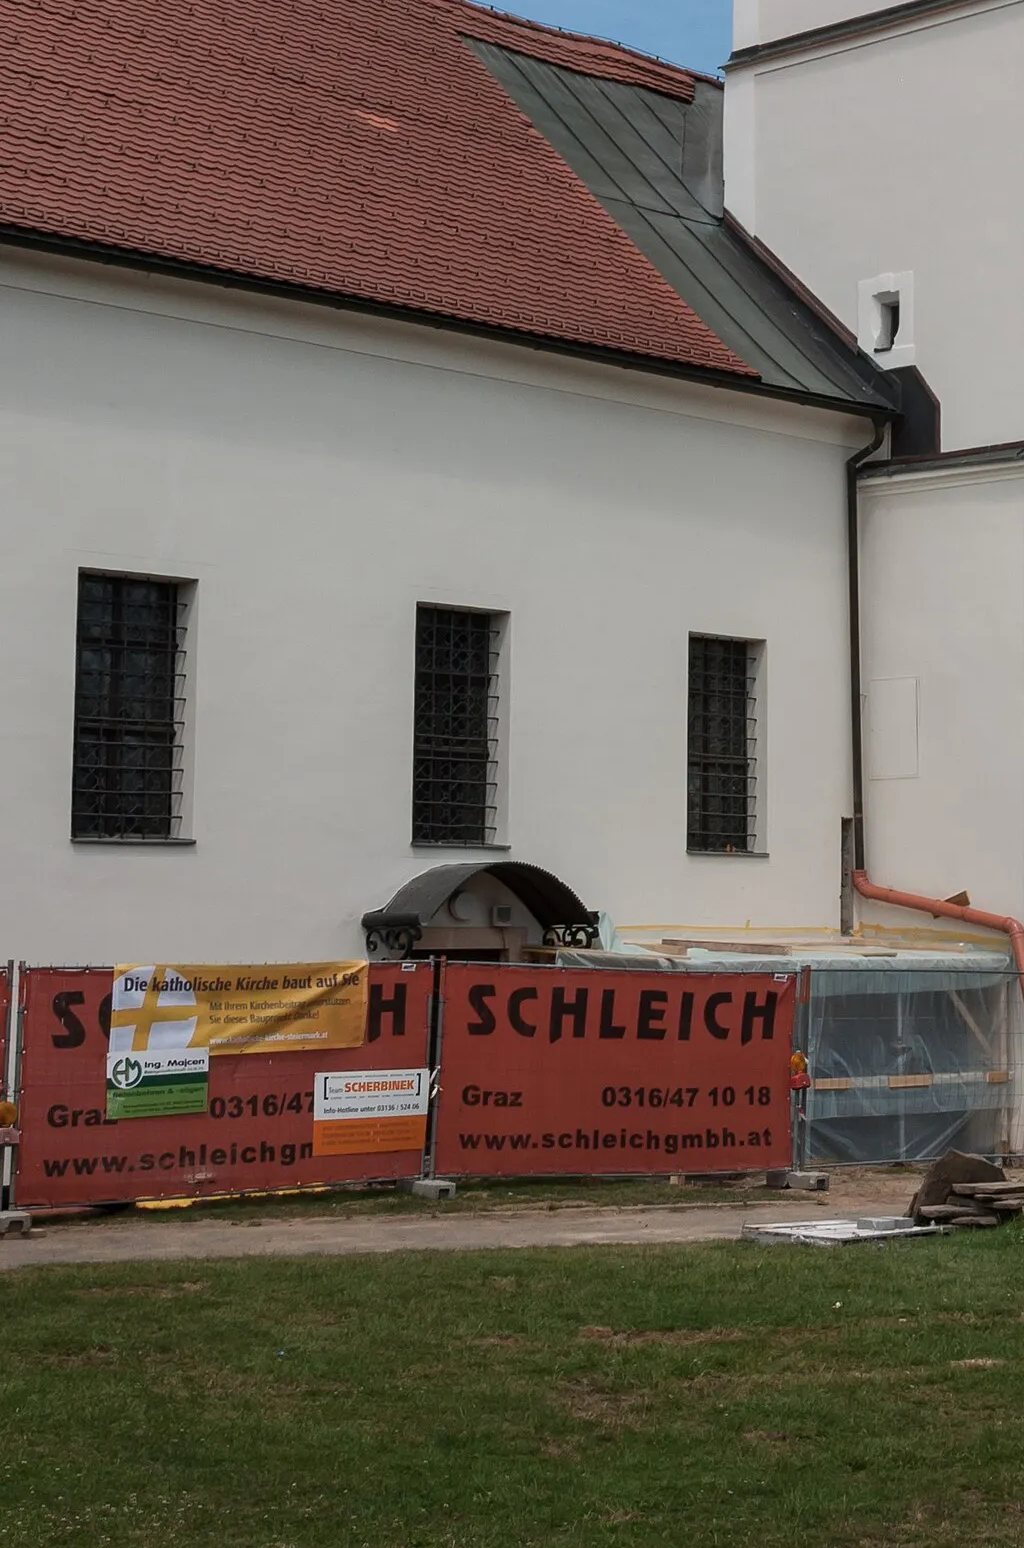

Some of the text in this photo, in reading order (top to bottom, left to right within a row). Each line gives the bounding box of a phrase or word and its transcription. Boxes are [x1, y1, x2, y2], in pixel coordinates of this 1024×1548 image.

[124, 973, 359, 992] Die katholische Kirche baut auf Sie
[210, 1001, 222, 1011] Mit
[225, 1000, 248, 1011] Ihrem
[210, 1014, 221, 1025] Sie
[224, 1013, 248, 1024] dieses
[466, 984, 778, 1046] SCHLEICH
[144, 1060, 164, 1070] Ing.
[167, 1058, 205, 1068] Majcen
[344, 1079, 415, 1093] SCHERBINEK
[462, 1085, 771, 1109] Graz 0316/47 10 18
[323, 1106, 359, 1114] Info-Hotline
[360, 1105, 376, 1113] unter
[458, 1127, 772, 1154] www.schleichgmbh.at
